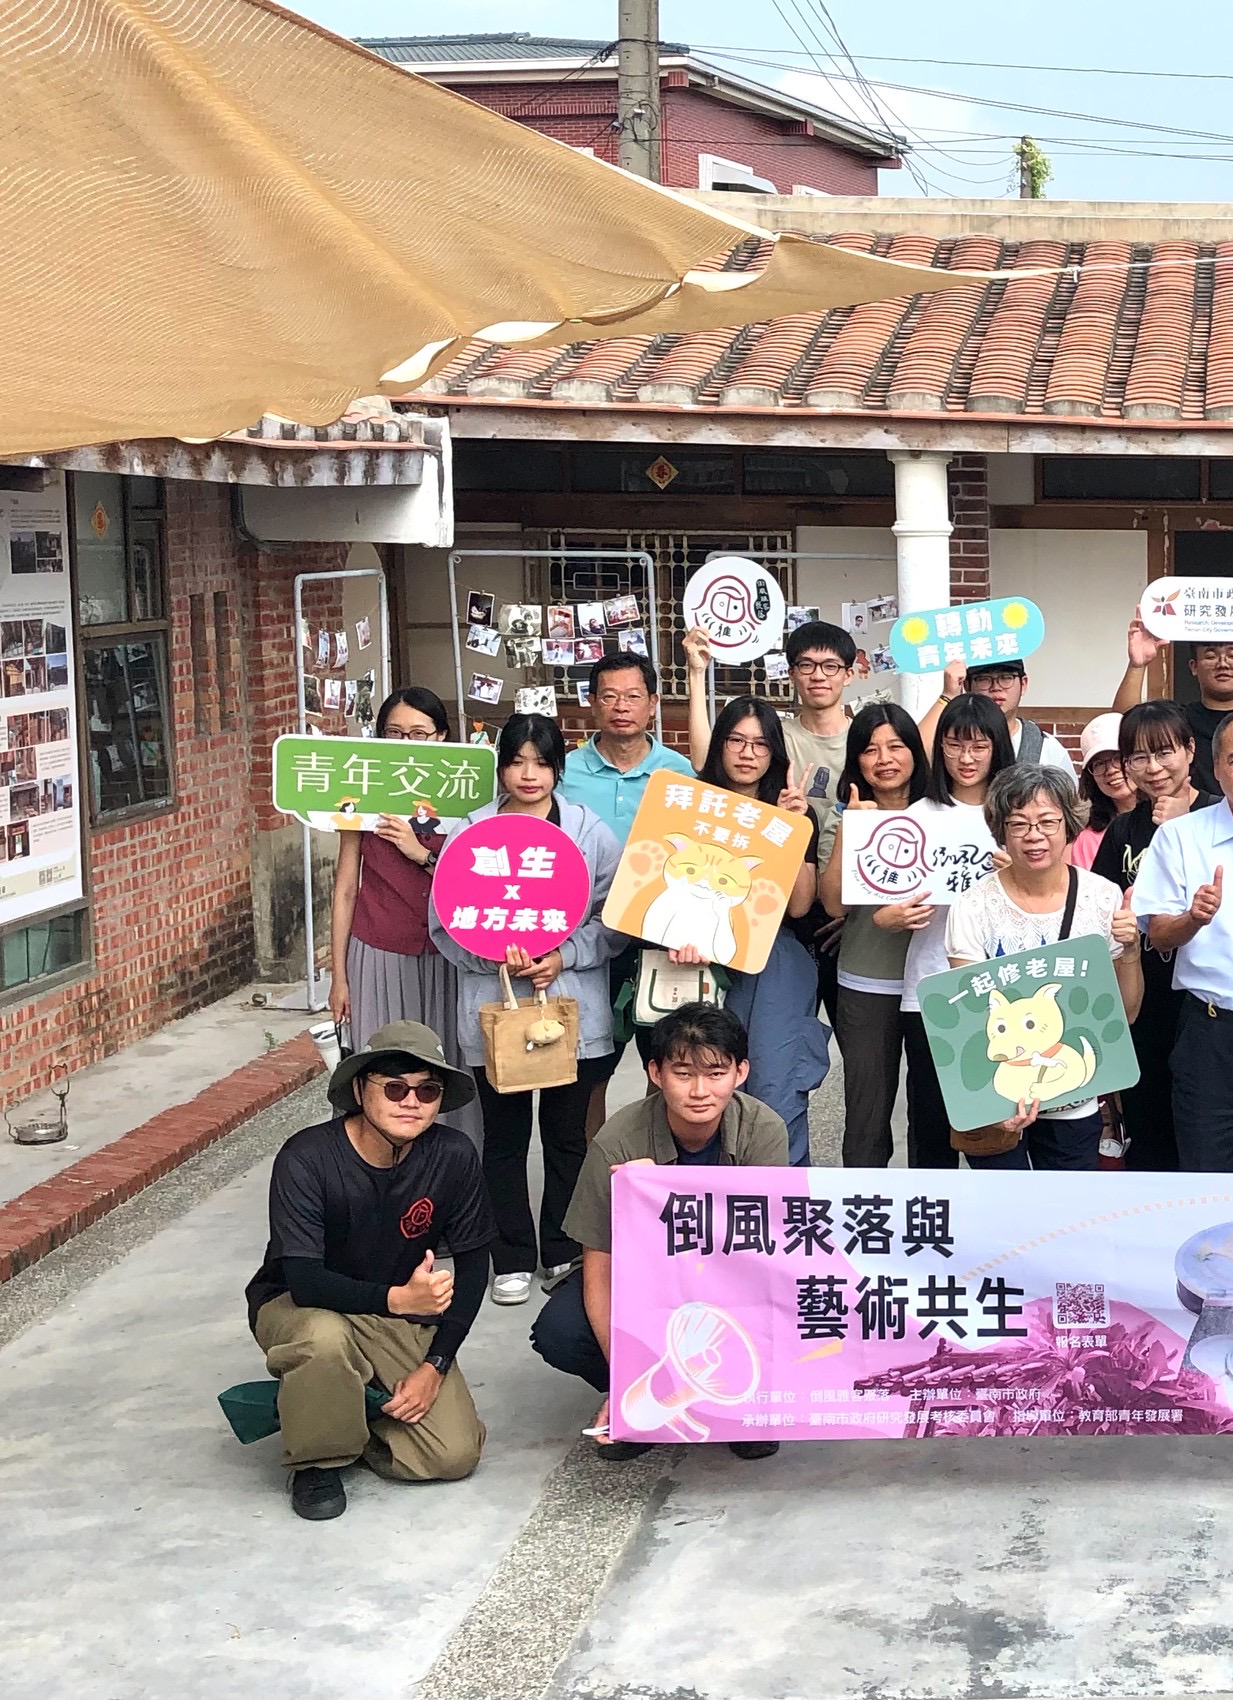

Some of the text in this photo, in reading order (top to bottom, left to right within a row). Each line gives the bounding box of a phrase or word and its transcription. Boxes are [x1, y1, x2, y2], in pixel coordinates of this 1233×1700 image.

[934, 607, 993, 639] 轉動
[916, 633, 1019, 669] 青年未來
[290, 752, 481, 800] 青年交流
[664, 783, 794, 848] 拜託老屋
[693, 819, 751, 850] 不要拆
[469, 844, 556, 878] 創生
[449, 905, 570, 933] 地方未來
[659, 1191, 954, 1258] 倒風聚落與
[796, 1274, 1028, 1340] 藝術共生
[1056, 1335, 1107, 1348] 報名表單
